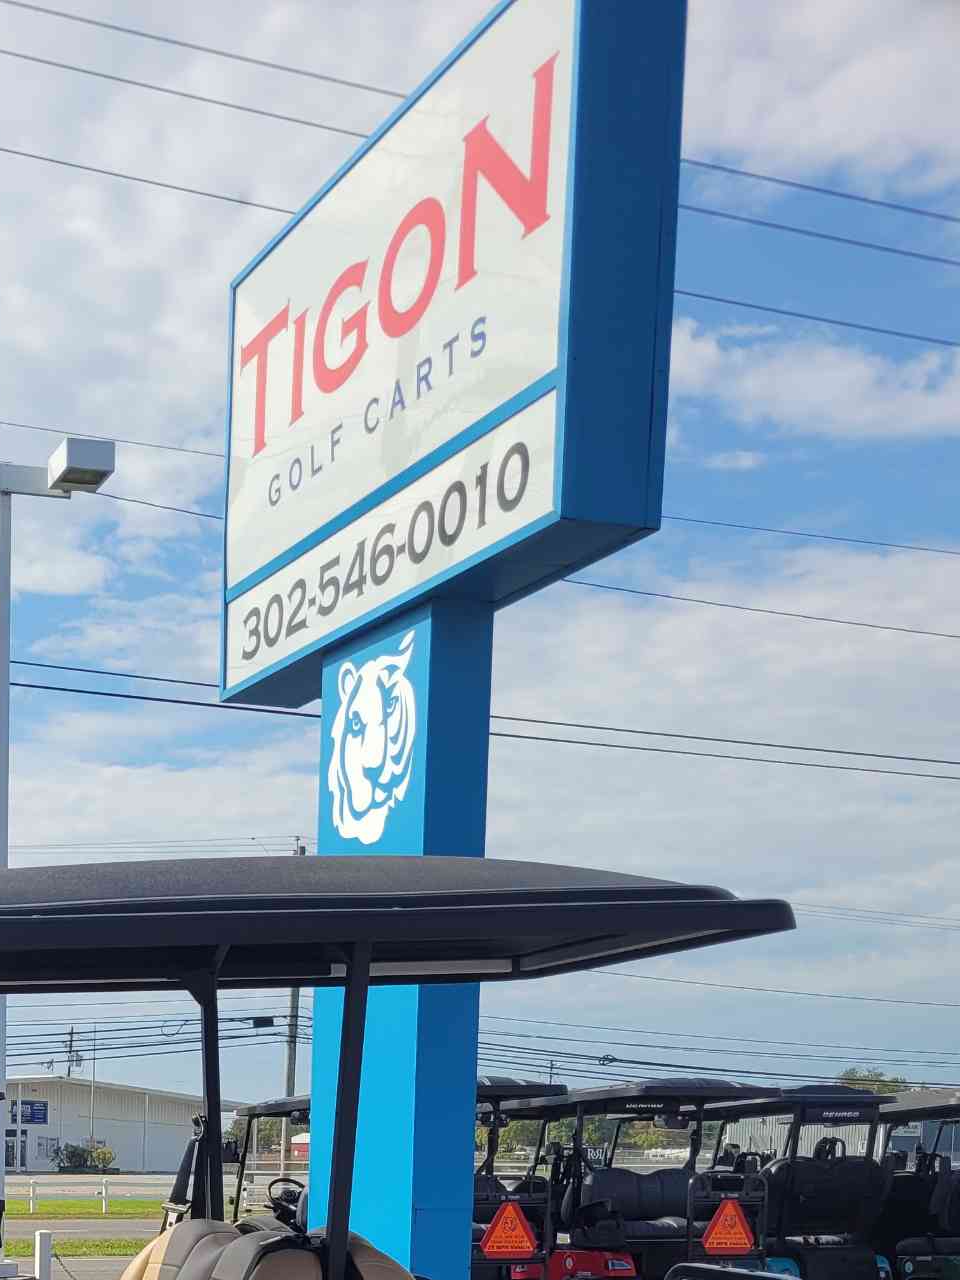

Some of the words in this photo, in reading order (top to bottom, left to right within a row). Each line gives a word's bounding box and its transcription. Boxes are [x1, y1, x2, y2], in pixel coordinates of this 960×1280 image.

[240, 51, 559, 458] TIGON
[268, 424, 342, 507] GOLF
[363, 316, 487, 434] CARTS
[241, 441, 530, 661] 302-546-0010
